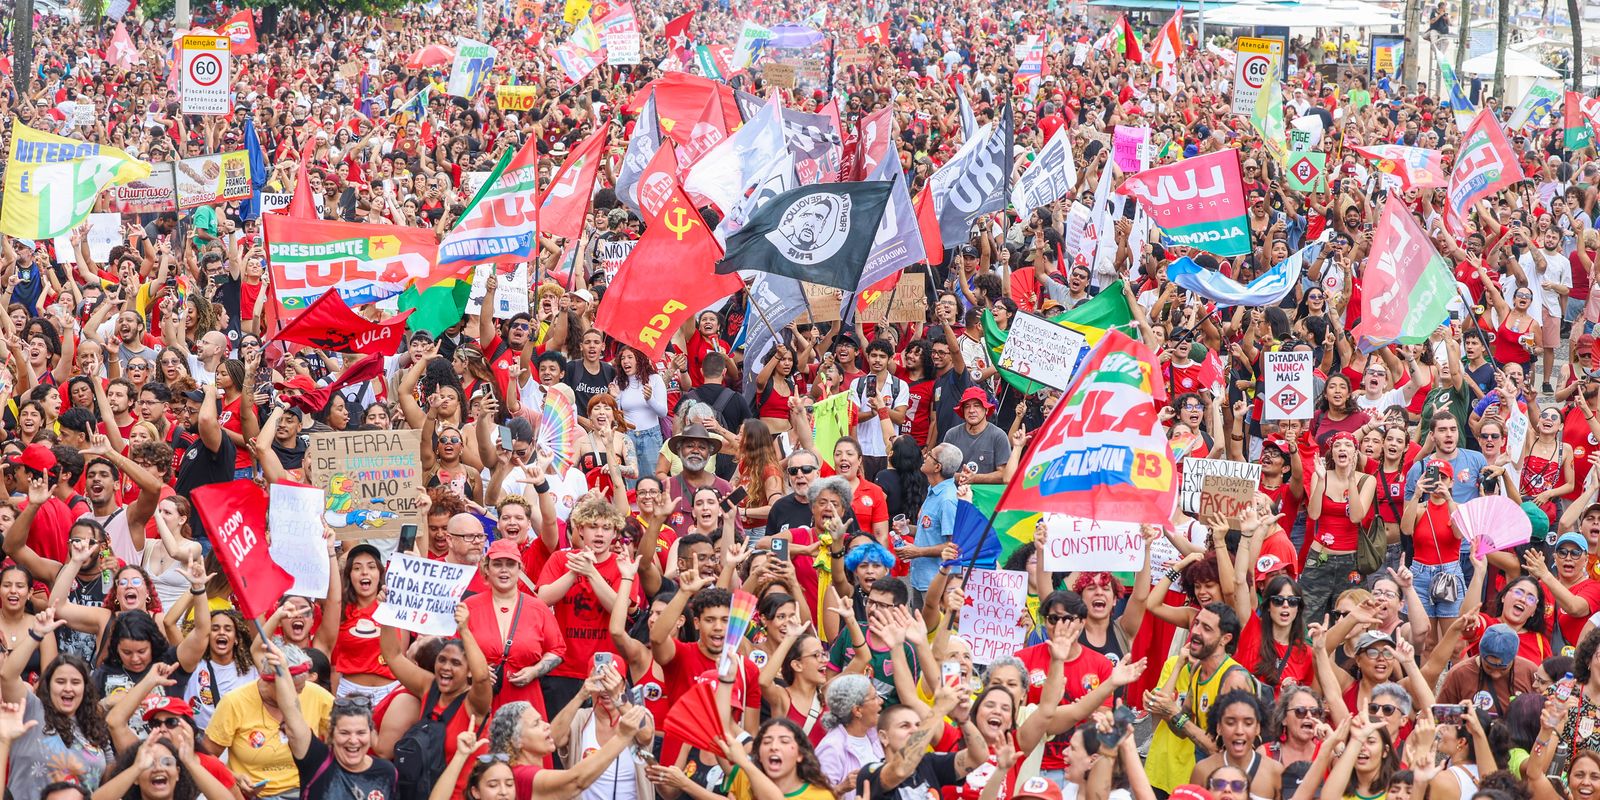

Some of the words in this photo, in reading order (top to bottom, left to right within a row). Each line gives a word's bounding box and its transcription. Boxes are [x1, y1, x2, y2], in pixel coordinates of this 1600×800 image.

[185, 39, 215, 47] Atenção
[1241, 41, 1270, 49] Atenção
[196, 61, 216, 75] 60
[1250, 63, 1267, 75] 60
[20, 170, 29, 193] É
[225, 176, 247, 186] FRANGO
[117, 184, 170, 200] Churrasco
[179, 192, 216, 205] CHURRASCO
[223, 185, 250, 197] CROCANTE
[270, 239, 364, 257] PRESIDENTE
[604, 241, 623, 260] NÃO
[272, 258, 409, 290] LULA
[355, 326, 391, 350] LULA
[1273, 363, 1305, 372] NUNCA
[1276, 371, 1300, 382] MAIS
[575, 382, 609, 394] Blessed
[1281, 393, 1297, 406] 22
[316, 438, 336, 451] EM
[338, 433, 404, 455] TERRA
[317, 456, 337, 470] DE
[345, 454, 384, 470] LOURO
[1135, 452, 1162, 478] 13
[357, 471, 380, 481] PATO
[1219, 460, 1239, 478] QUE
[1240, 463, 1260, 480] UM
[361, 479, 399, 498] NÃO
[402, 481, 412, 489] SE
[1204, 475, 1254, 488] ESTUDANTES
[387, 497, 418, 511] CRIA
[224, 510, 244, 537] COM
[1090, 519, 1101, 532] A
[229, 525, 257, 568] ULA
[1051, 530, 1142, 559] CONSTITUIÇÃO
[402, 558, 439, 577] VOTE
[439, 565, 463, 580] PELO
[1261, 559, 1272, 569] 13
[386, 571, 406, 589] FIM
[406, 578, 419, 593] DA
[421, 581, 450, 597] ESCALA
[982, 571, 1024, 590] PRECISO
[405, 593, 424, 610] NÃO
[395, 609, 408, 620] NA
[977, 603, 1015, 622] RAÇA
[973, 619, 1015, 640] GANA
[754, 655, 765, 663] 13
[647, 688, 659, 697] 13
[1030, 780, 1044, 789] 13
